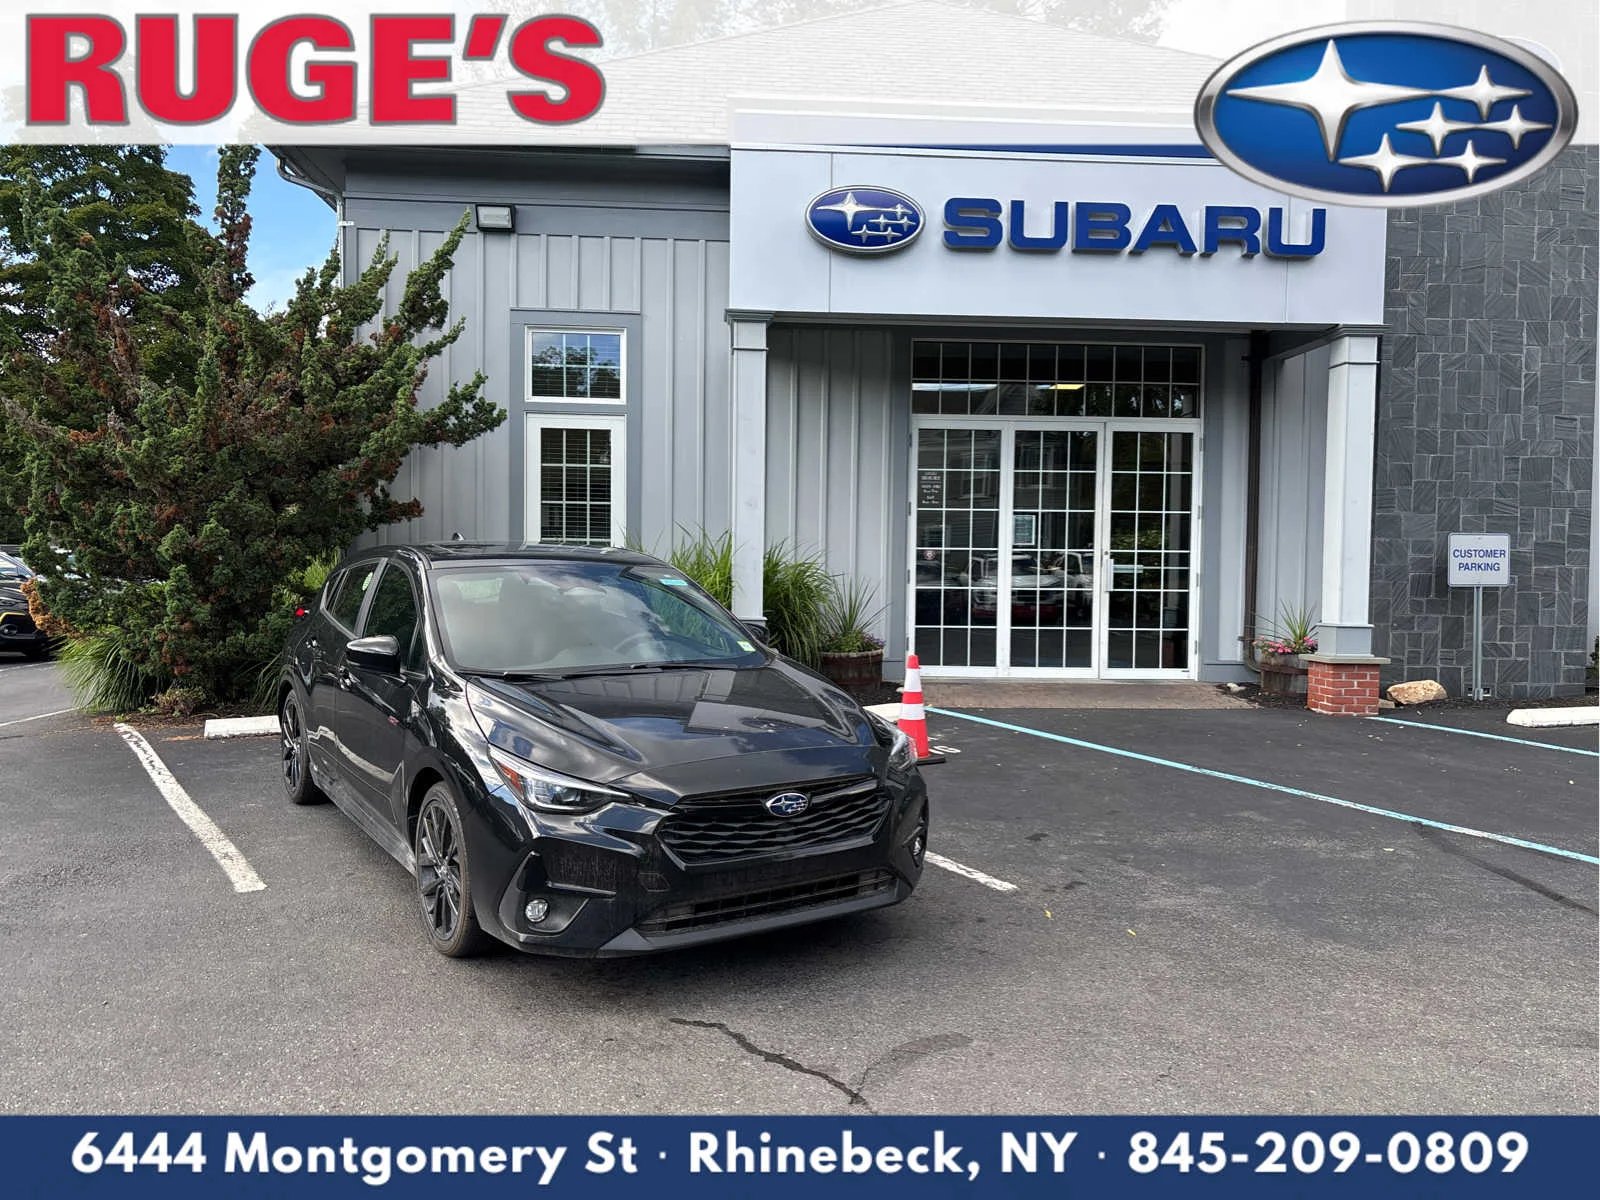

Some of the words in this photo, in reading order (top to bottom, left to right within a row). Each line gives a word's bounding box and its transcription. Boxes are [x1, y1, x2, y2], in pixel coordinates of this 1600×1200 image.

[943, 197, 1327, 258] SUBARU
[1452, 548, 1506, 559] CUSTOMER
[1458, 562, 1501, 572] PARKING
